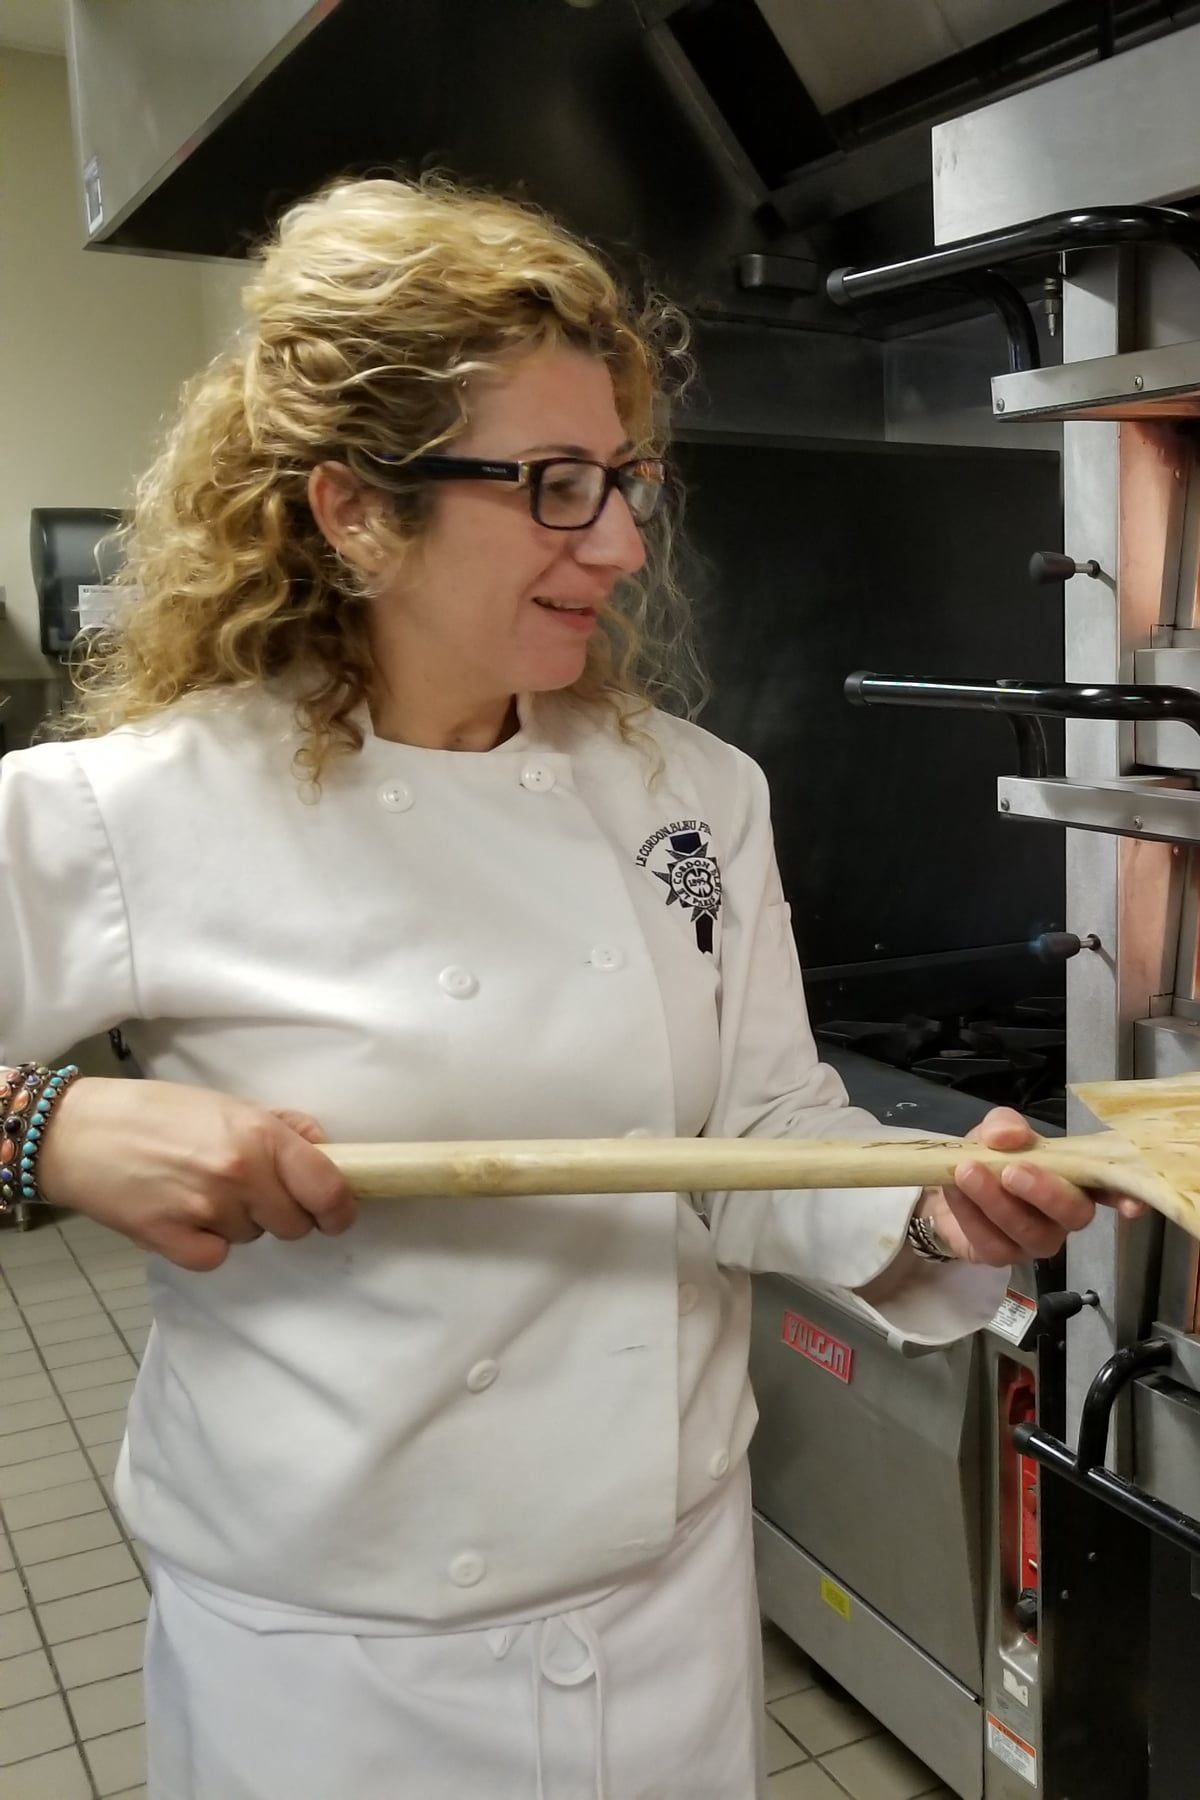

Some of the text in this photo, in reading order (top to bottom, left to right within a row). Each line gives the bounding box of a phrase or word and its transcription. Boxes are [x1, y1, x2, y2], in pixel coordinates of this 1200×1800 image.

[669, 820, 697, 834] BLEU
[639, 826, 671, 857] CORDON
[635, 855, 647, 867] LE
[673, 860, 710, 884] CORDON
[789, 1320, 845, 1374] VULCAN
